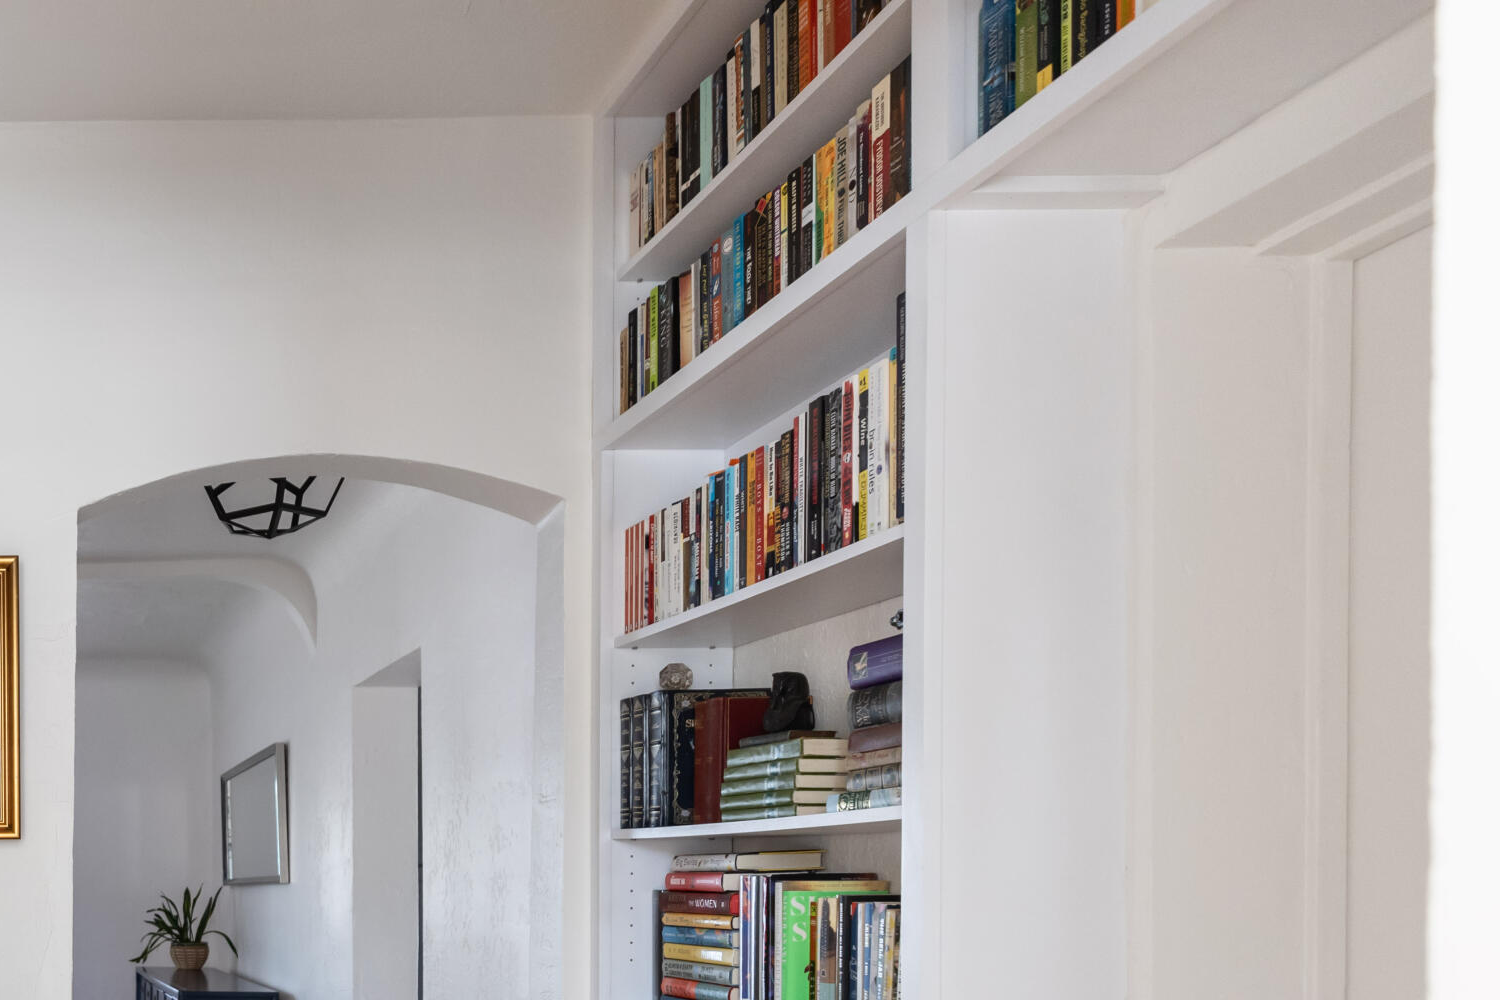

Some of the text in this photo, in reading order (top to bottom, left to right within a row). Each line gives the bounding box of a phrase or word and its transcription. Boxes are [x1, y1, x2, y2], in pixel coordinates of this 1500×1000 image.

[837, 137, 846, 185] JOE HILL
[875, 139, 883, 173] FYODOR
